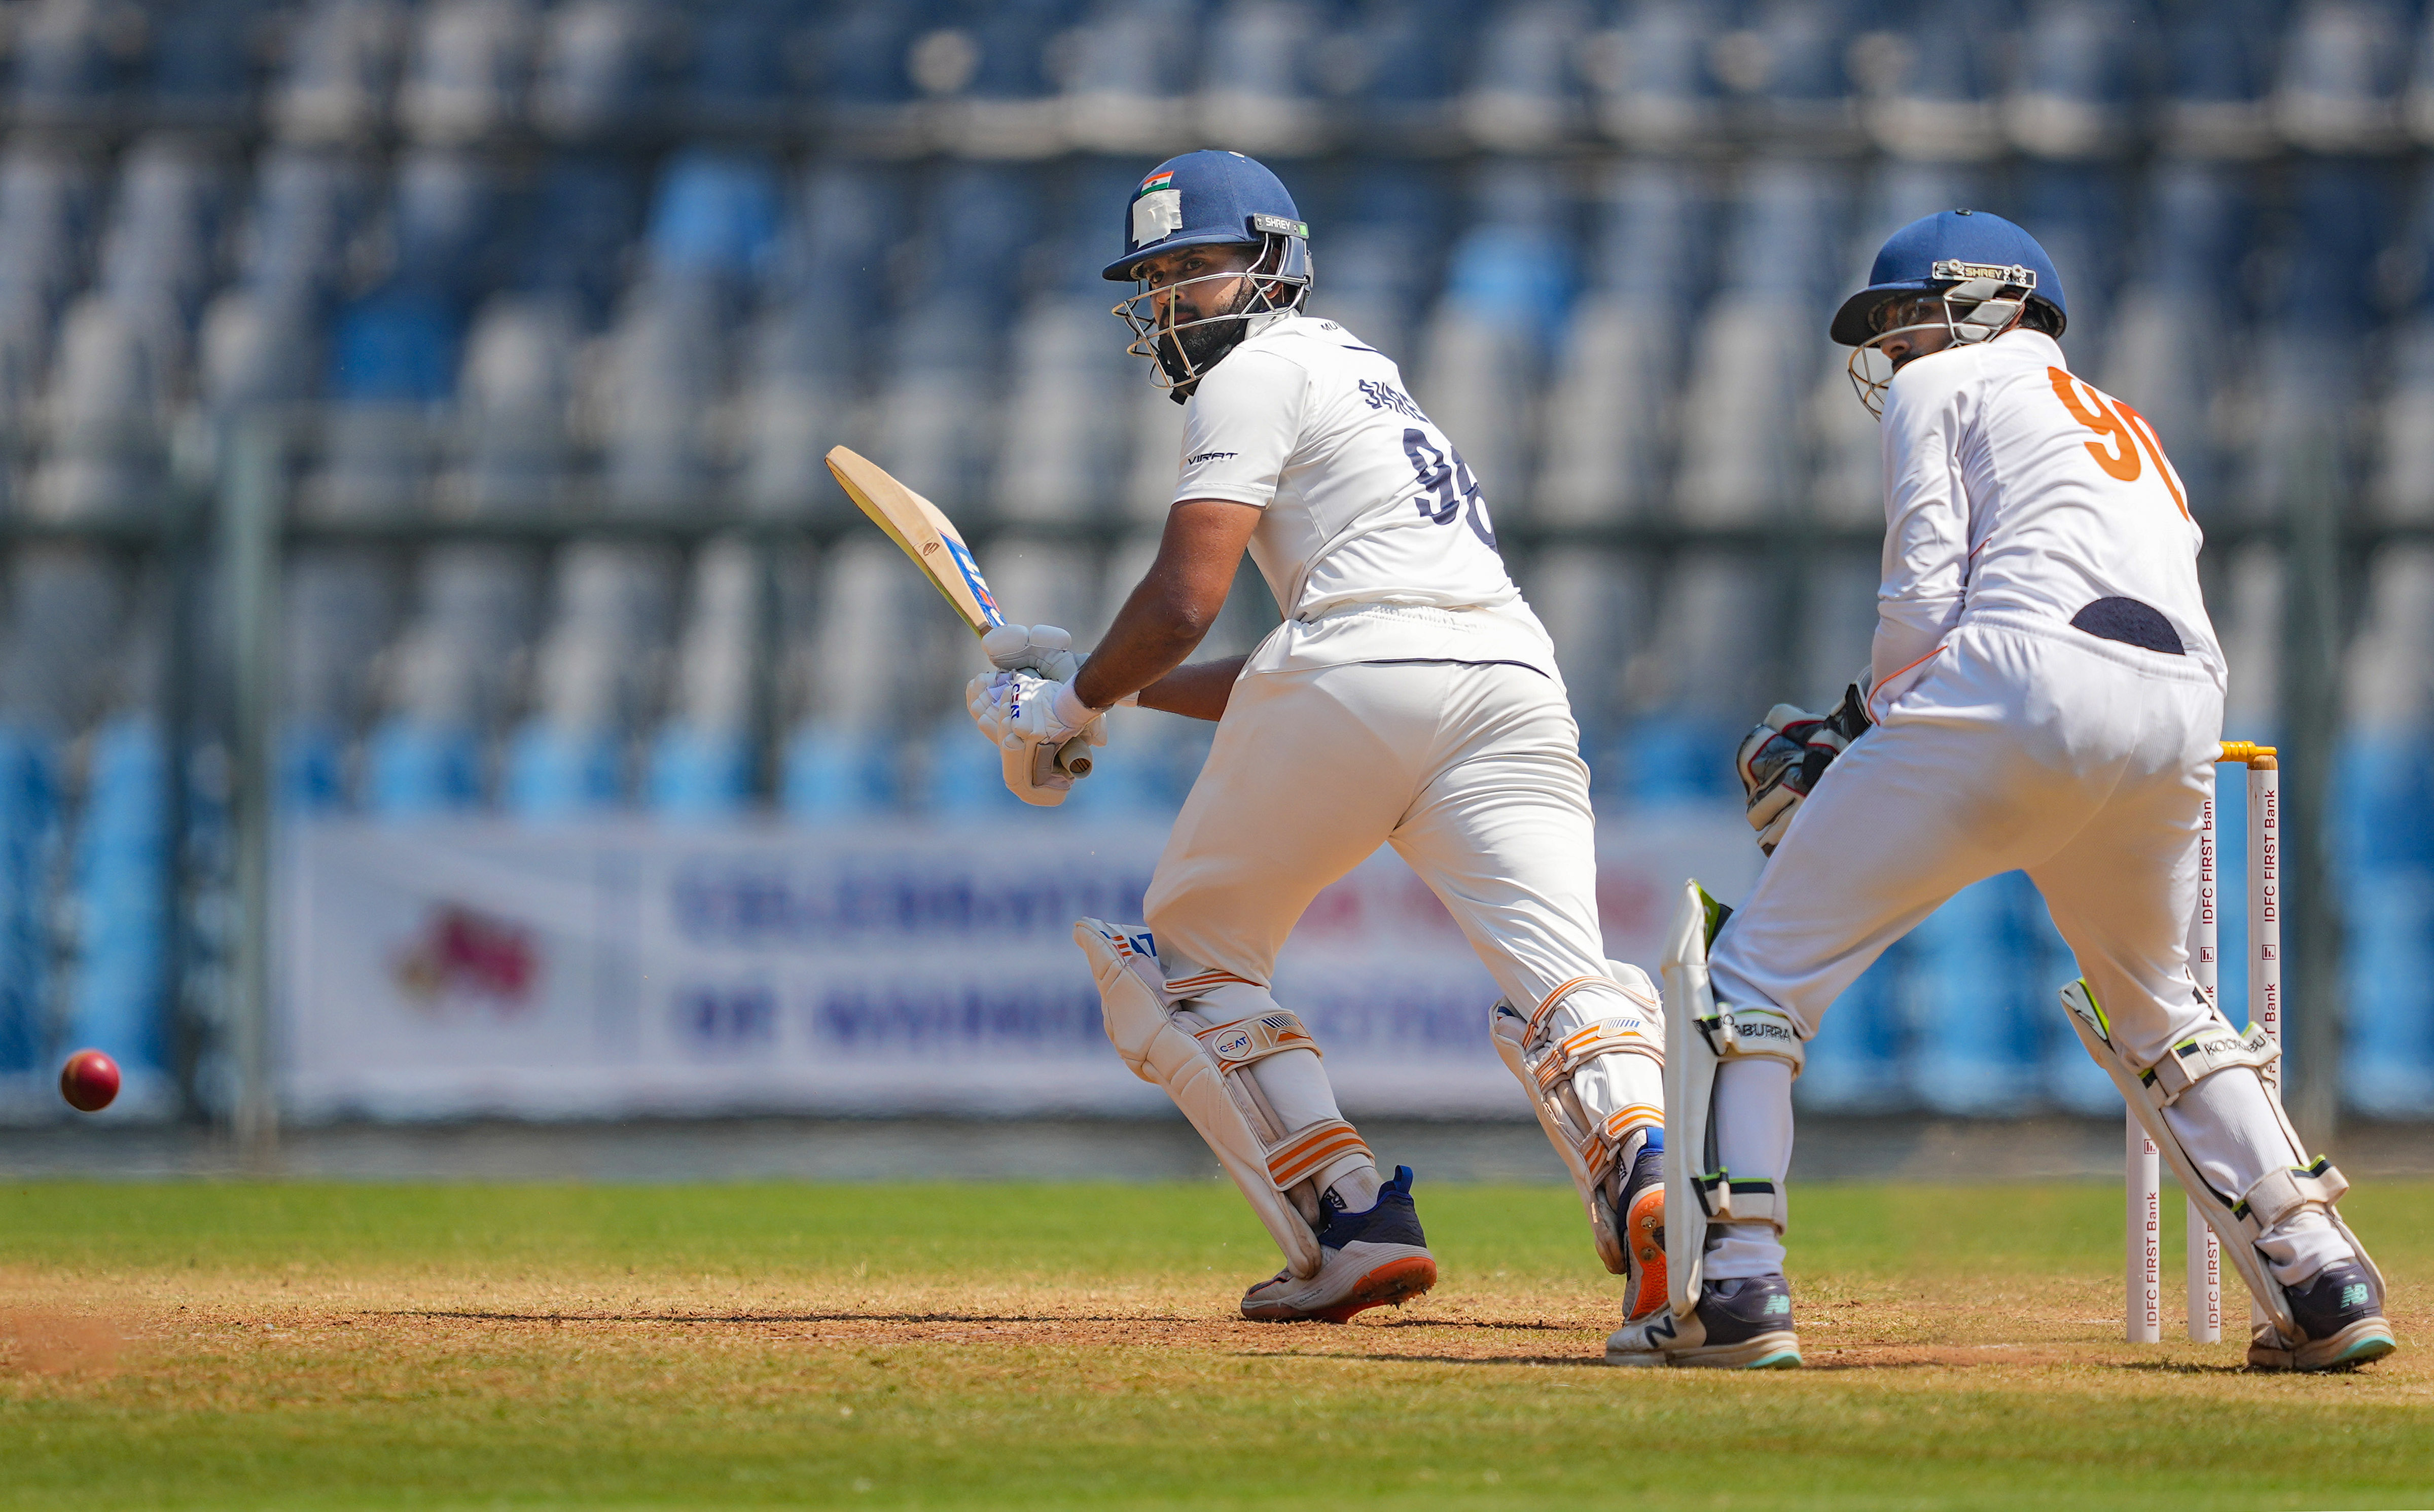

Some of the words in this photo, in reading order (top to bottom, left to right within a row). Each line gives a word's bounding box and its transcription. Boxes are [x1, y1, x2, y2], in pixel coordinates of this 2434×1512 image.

[1265, 217, 1291, 230] SHREY
[1964, 267, 2002, 279] SHREY
[1358, 379, 1430, 424] SHRE
[1011, 683, 1020, 719] CEAT
[2202, 799, 2212, 831] Ban
[2264, 789, 2275, 829] Bank
[2202, 836, 2212, 882] FIRST
[2264, 834, 2275, 879] FIRST
[2202, 887, 2213, 924] IDFC
[2264, 885, 2275, 922] IDFC
[1099, 930, 1157, 958] EAT
[2265, 984, 2275, 1022] Bank
[1220, 1036, 1247, 1053] CEAT
[2146, 1192, 2157, 1231] Bank
[2146, 1238, 2157, 1283] FIRST
[2208, 1239, 2218, 1285] FIRST
[2146, 1289, 2157, 1327] IDFC
[2209, 1291, 2218, 1328] IDFC
